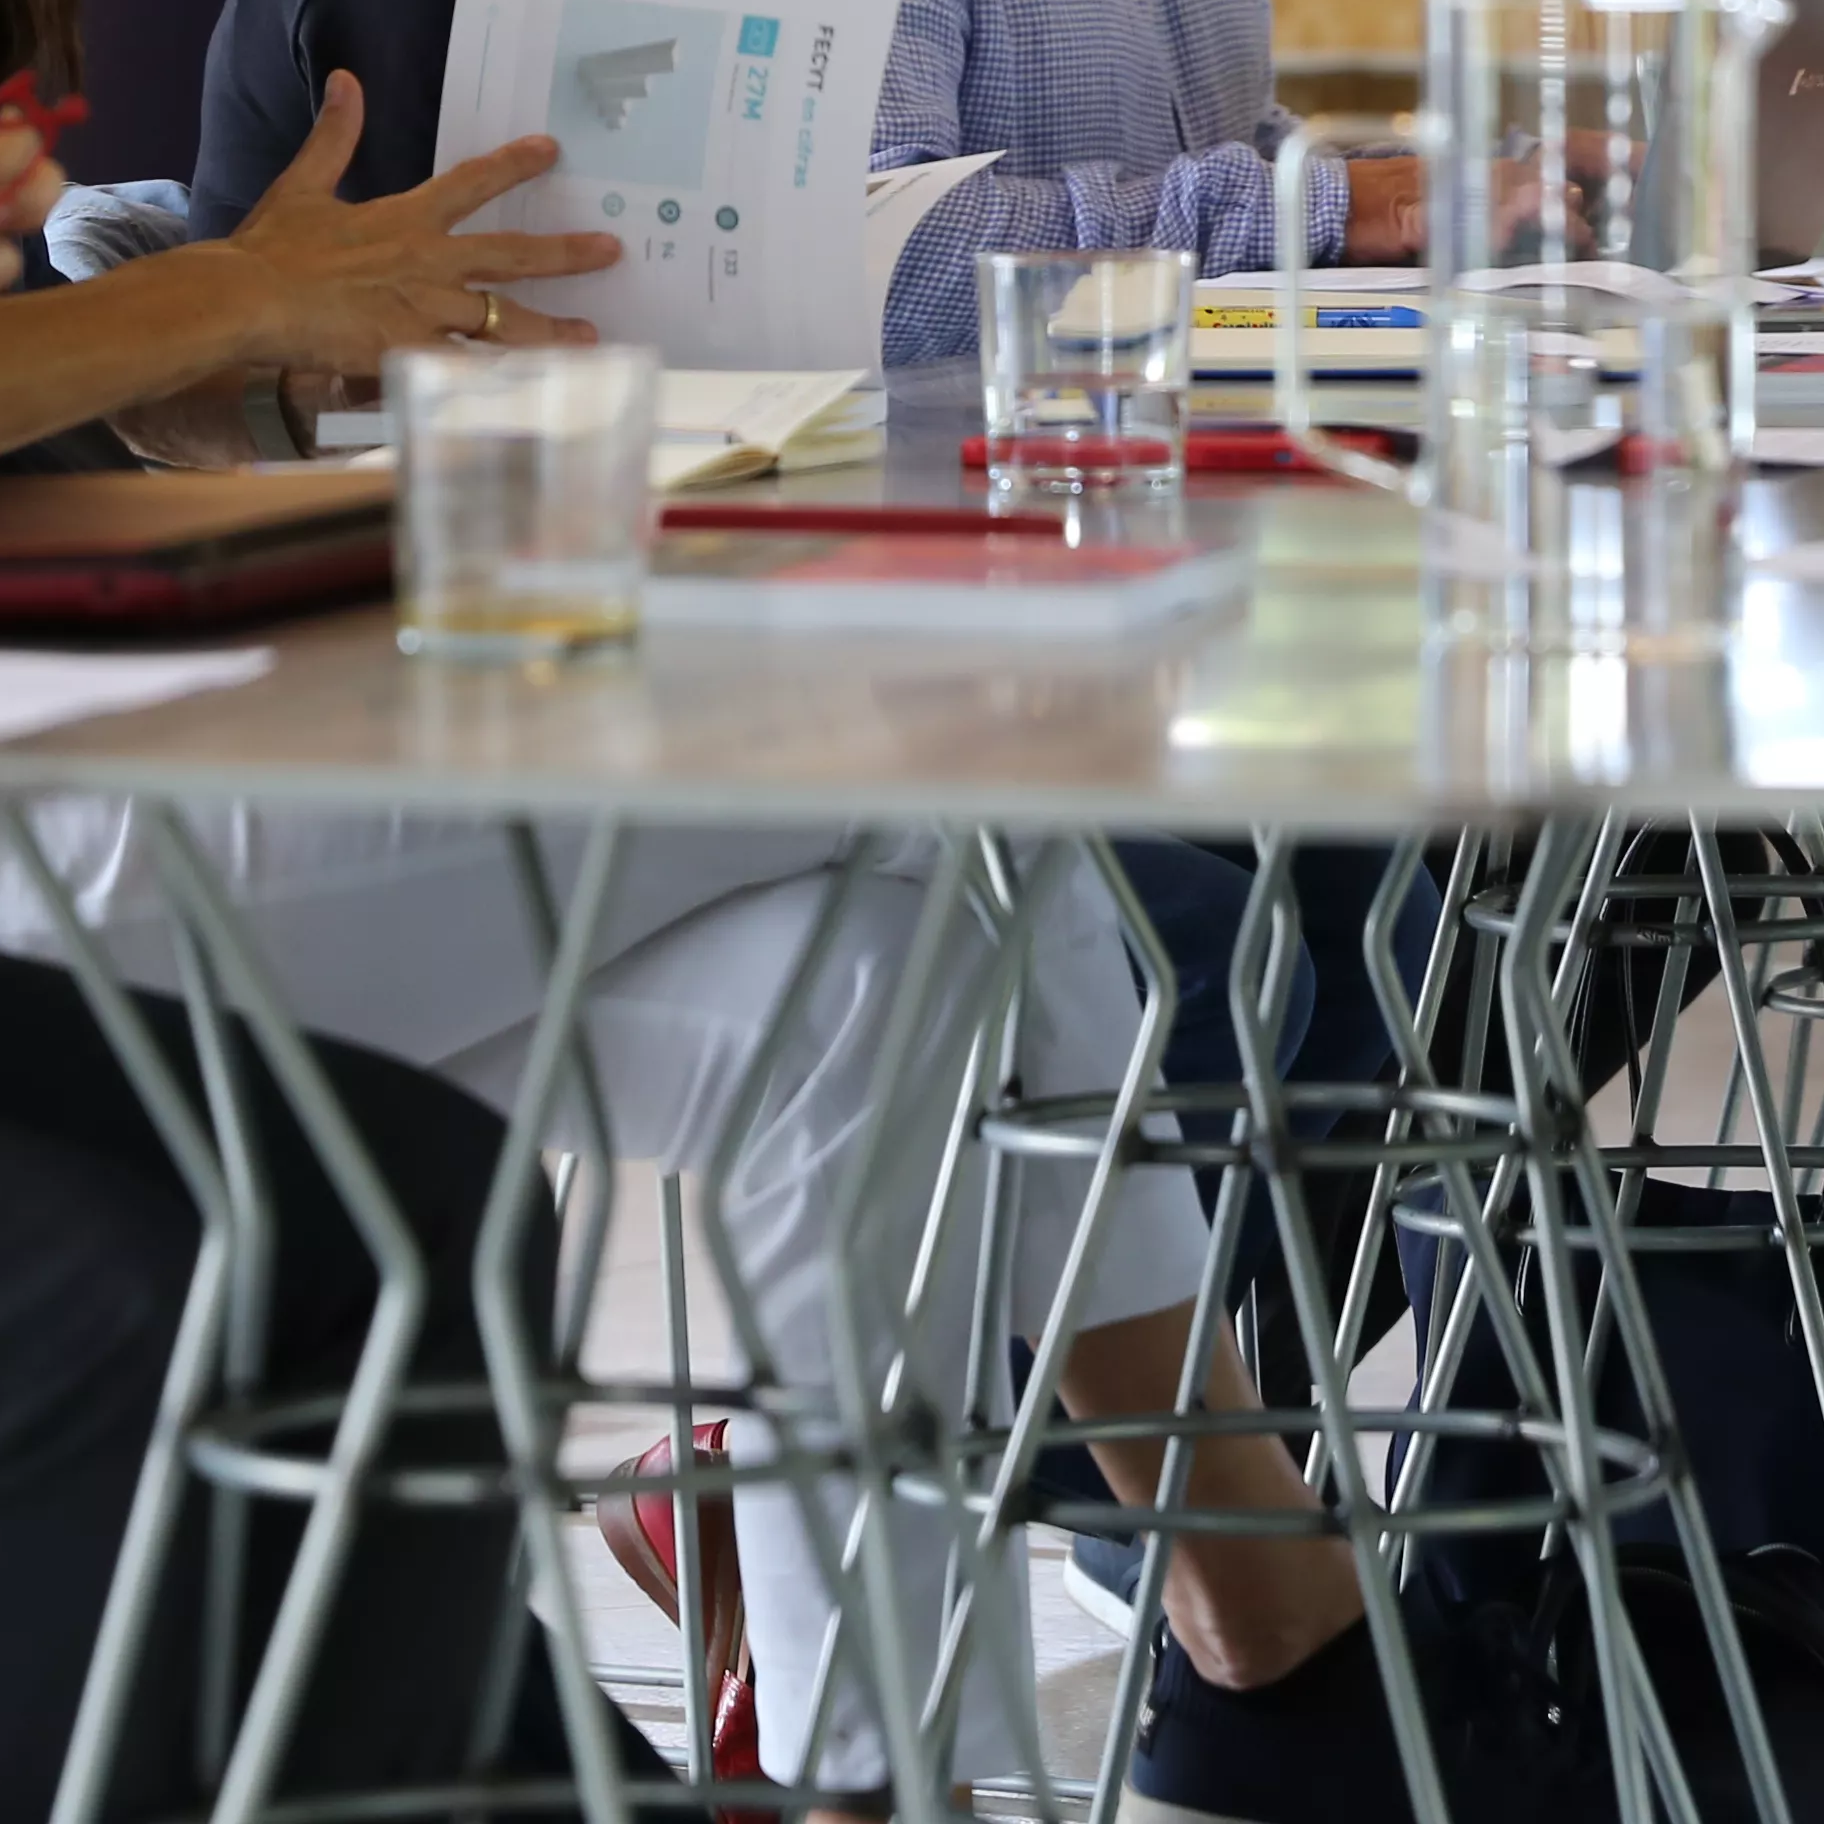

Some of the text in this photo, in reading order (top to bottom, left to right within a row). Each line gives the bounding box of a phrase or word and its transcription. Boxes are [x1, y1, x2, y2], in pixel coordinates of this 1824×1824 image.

[741, 64, 770, 121] 27M
[793, 24, 835, 189] FECYT en cifras
